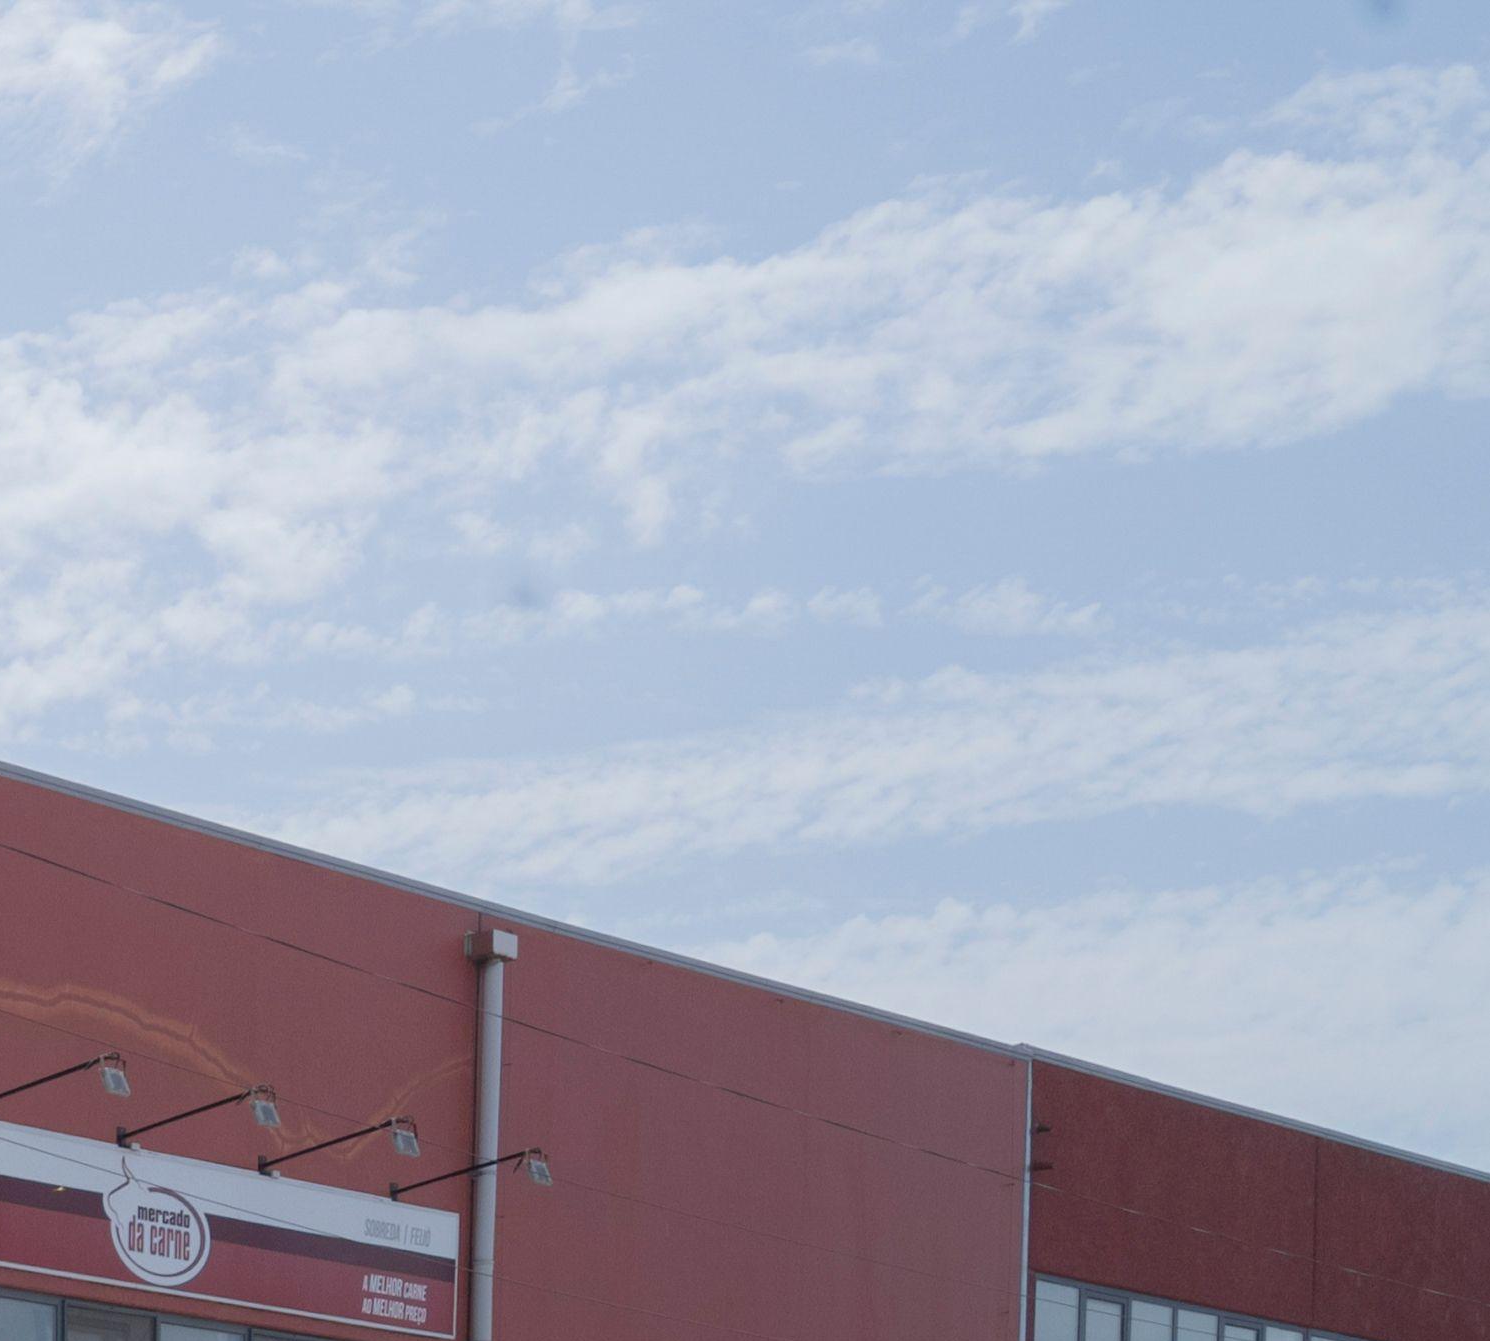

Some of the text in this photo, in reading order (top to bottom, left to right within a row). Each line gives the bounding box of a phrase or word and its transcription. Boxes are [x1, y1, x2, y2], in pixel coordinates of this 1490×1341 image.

[137, 1205, 191, 1229] mercado
[128, 1213, 191, 1262] da carne
[361, 1273, 428, 1302] A MELHOR CARNE
[372, 1297, 405, 1320] MELHOR
[405, 1304, 428, 1326] PREÇO
